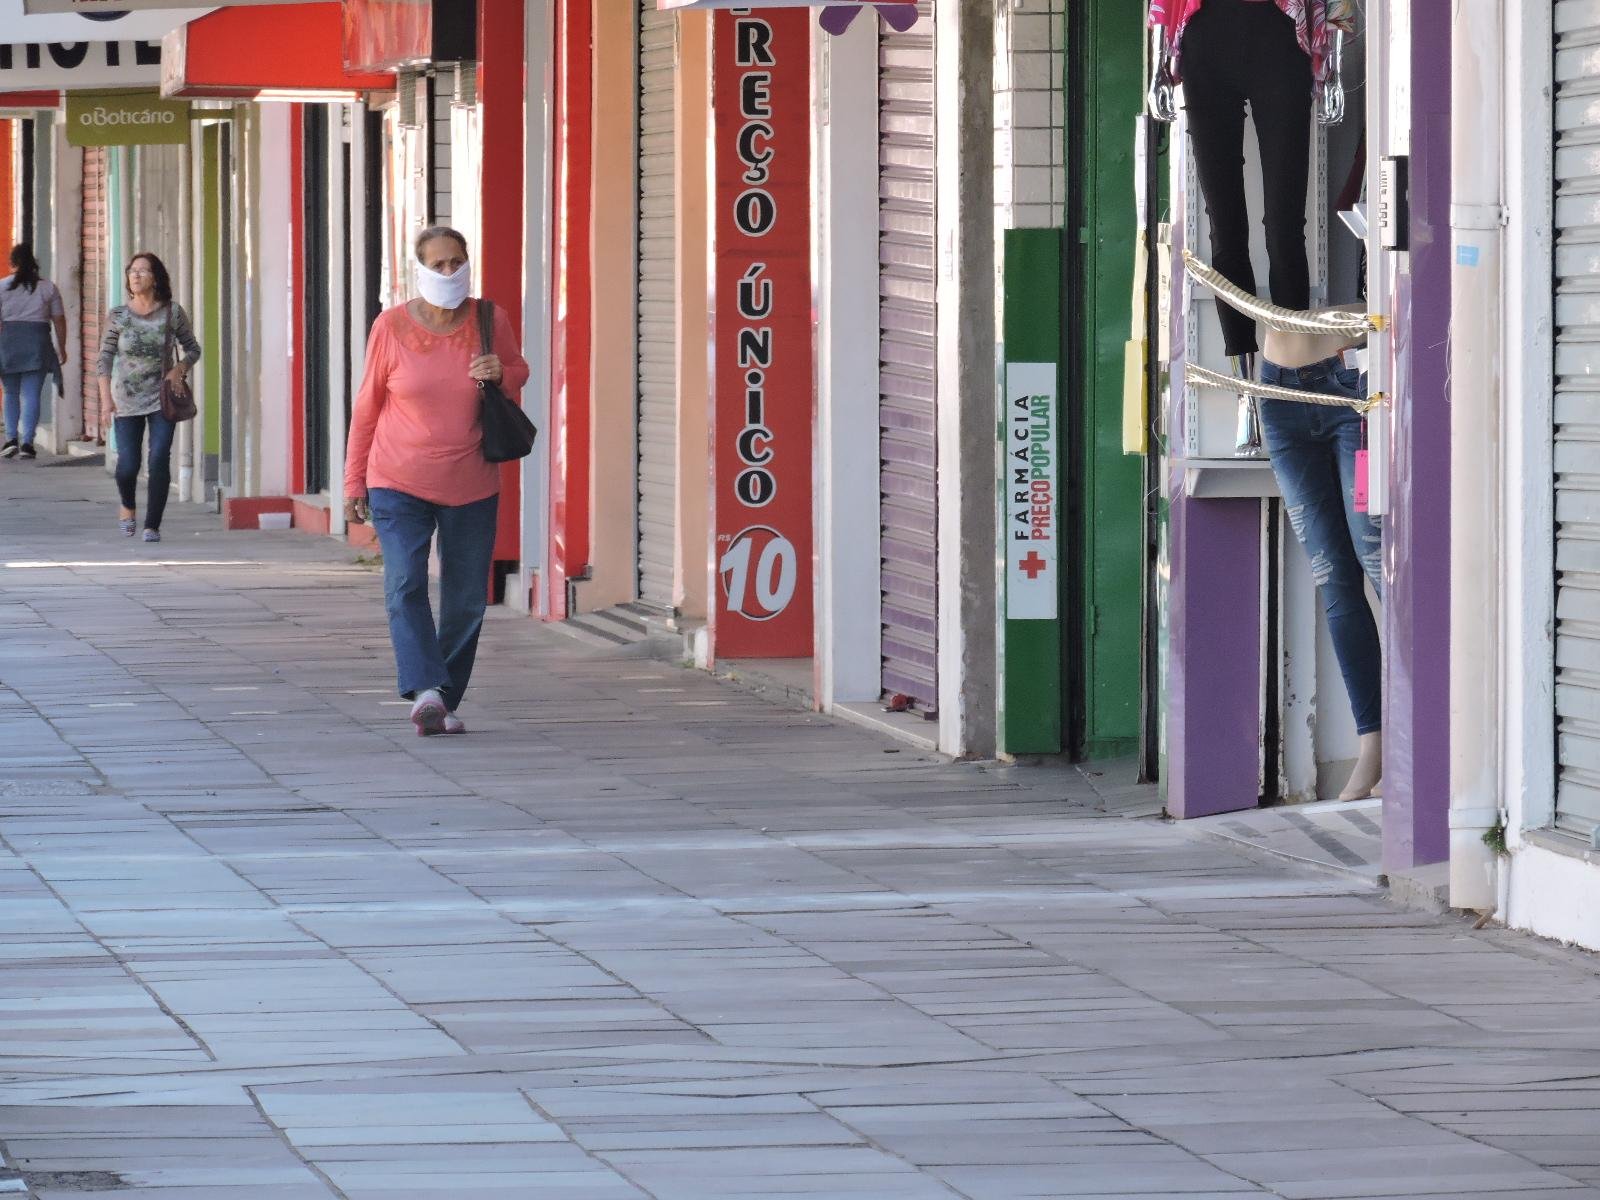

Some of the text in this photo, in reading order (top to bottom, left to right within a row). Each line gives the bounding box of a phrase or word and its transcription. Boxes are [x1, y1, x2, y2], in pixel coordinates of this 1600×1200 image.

[80, 107, 175, 126] oBoticário
[730, 9, 777, 238] REÇO
[1010, 395, 1029, 541] FARMÁCIA
[719, 536, 797, 614] 10
